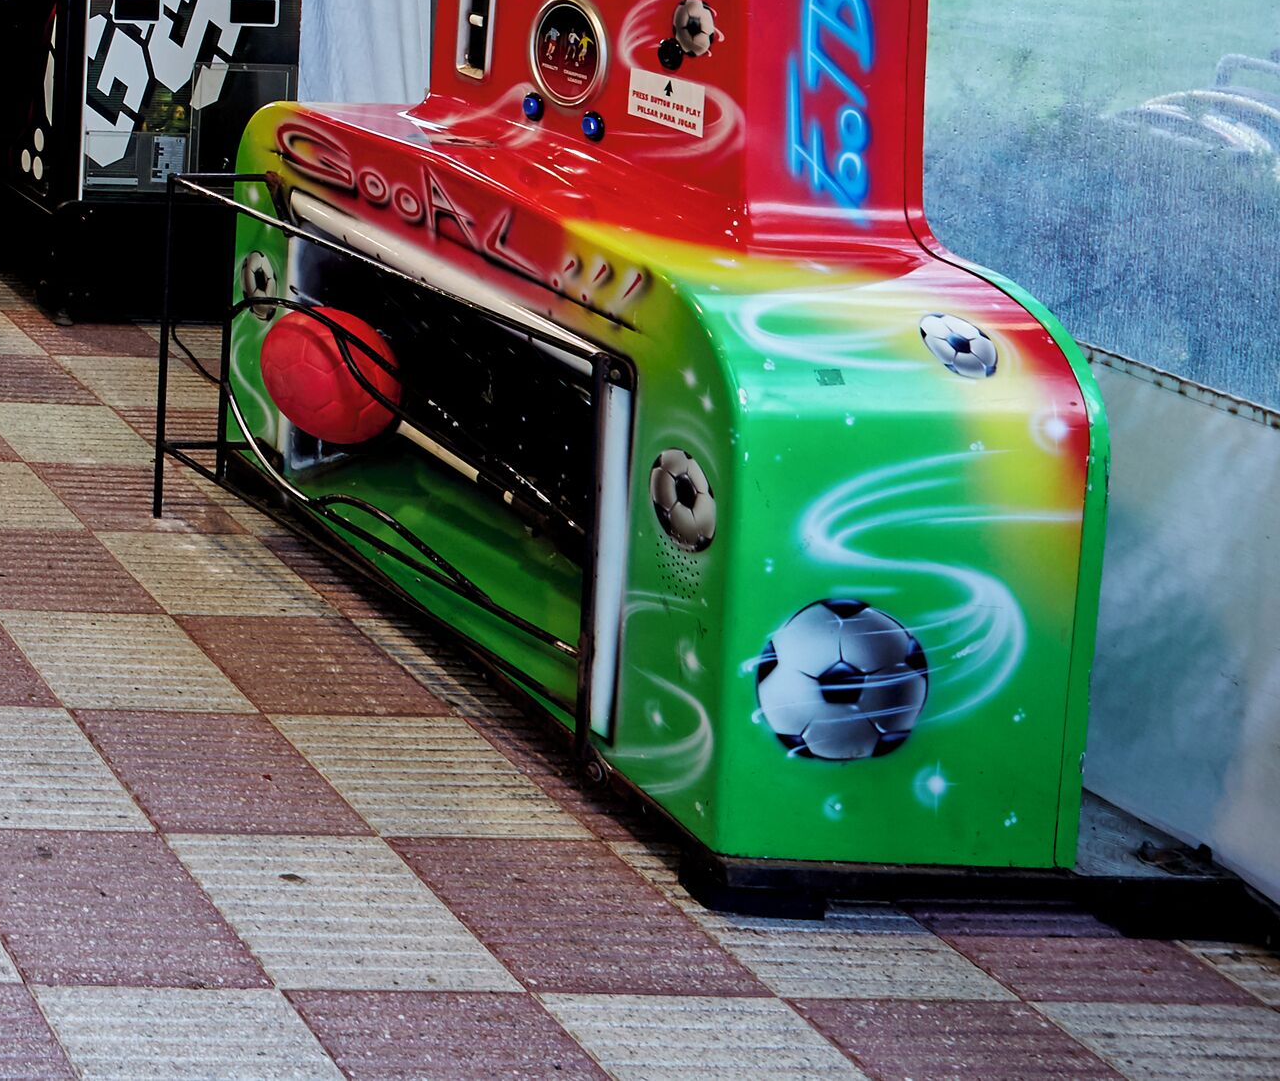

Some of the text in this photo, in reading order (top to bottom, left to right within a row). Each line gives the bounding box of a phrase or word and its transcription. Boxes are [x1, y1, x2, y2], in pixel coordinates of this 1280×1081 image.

[632, 90, 702, 118] PRESS BUTTON FOR PLAY
[637, 105, 697, 131] PULSAR PARA JUGAR
